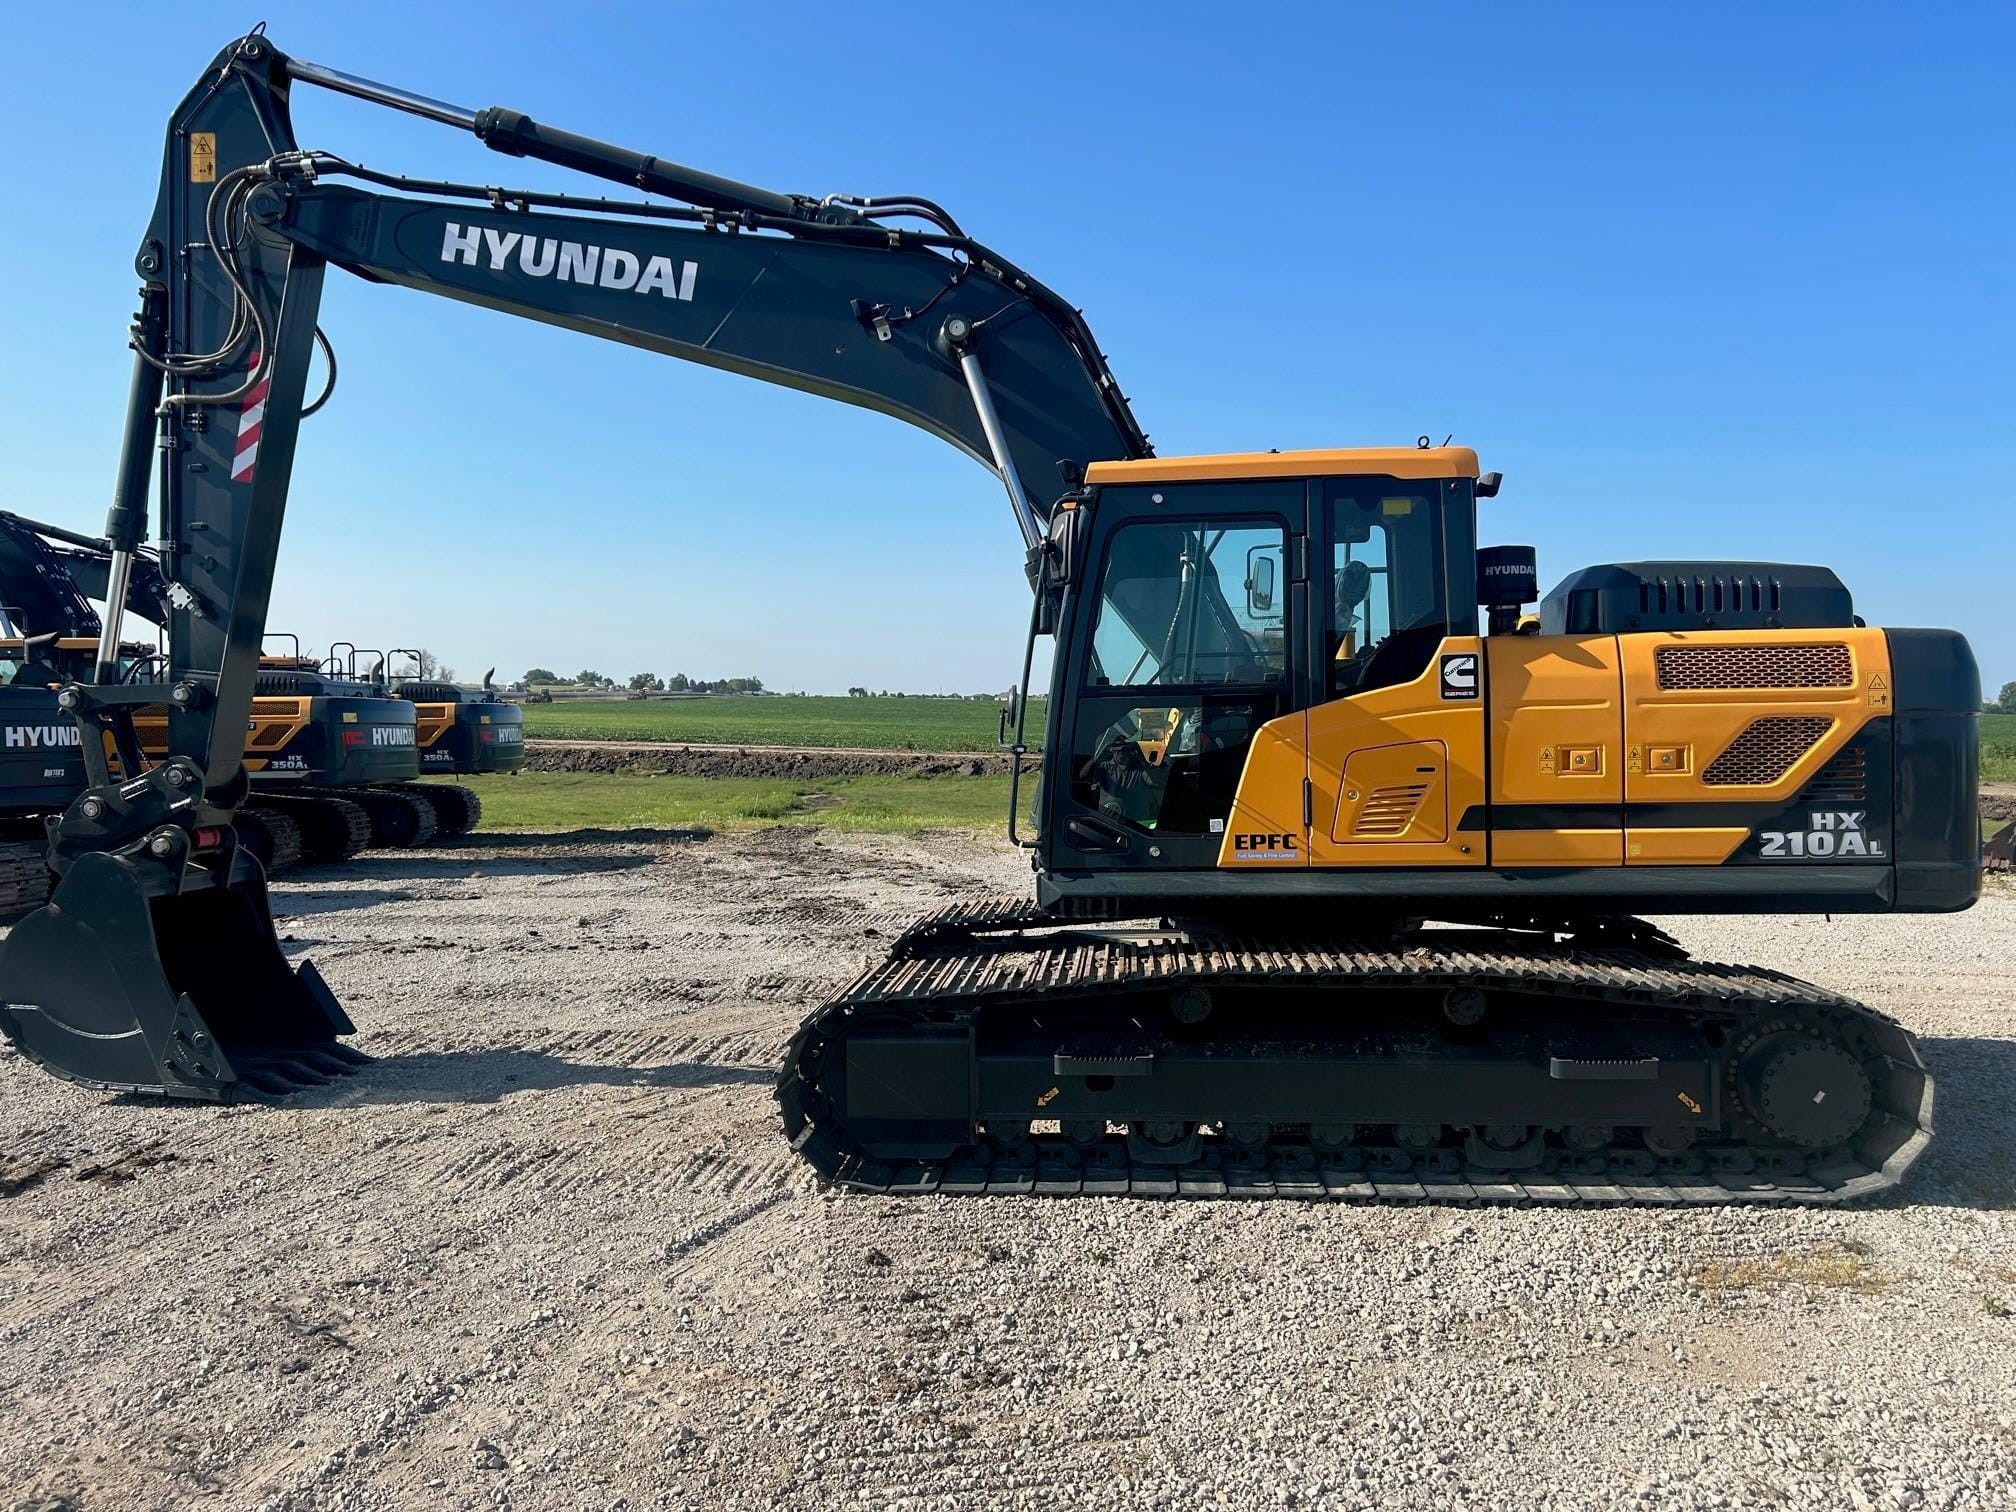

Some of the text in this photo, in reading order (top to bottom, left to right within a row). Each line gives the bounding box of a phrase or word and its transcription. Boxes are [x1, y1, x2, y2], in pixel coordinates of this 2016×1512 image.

[440, 222, 699, 301] HYUNDAI
[1485, 565, 1535, 575] HYUNDAI
[1445, 657, 1472, 677] Cummins
[5, 726, 82, 747] HYUND
[372, 727, 415, 745] HYUNDAI
[1811, 812, 1861, 830] HX
[1234, 833, 1298, 850] EPFC
